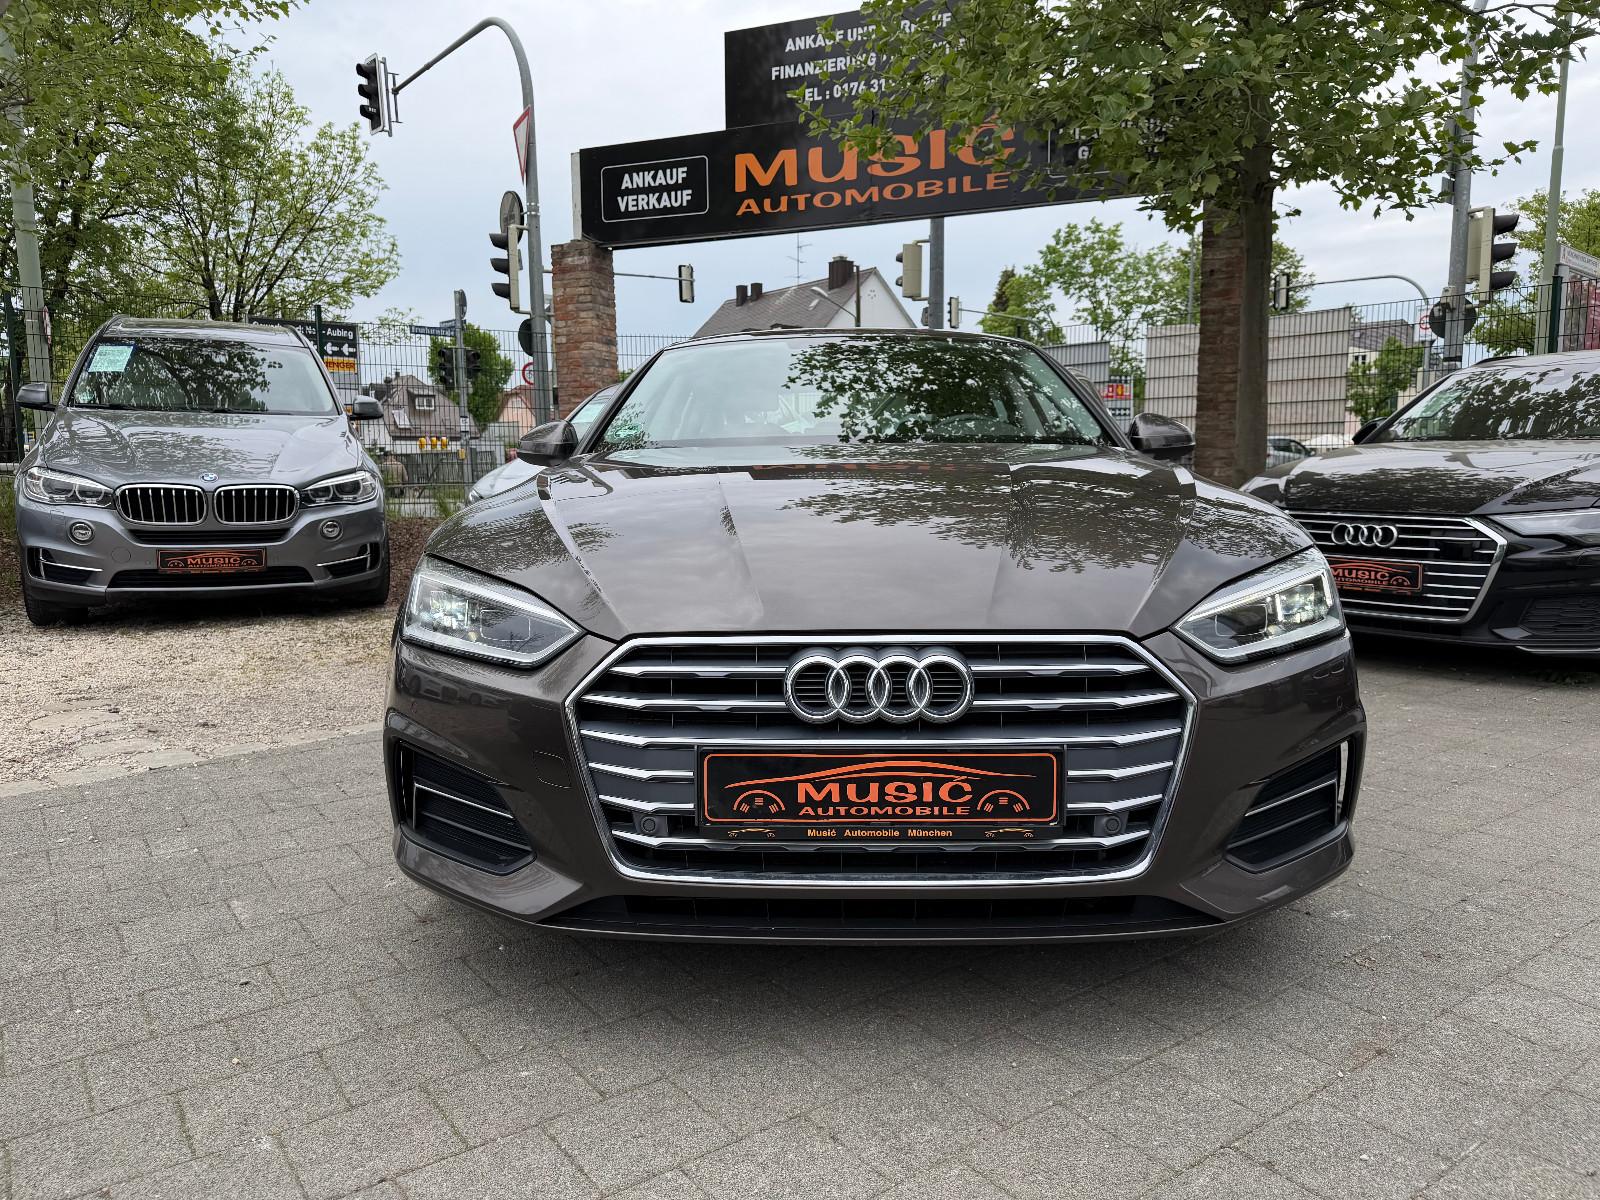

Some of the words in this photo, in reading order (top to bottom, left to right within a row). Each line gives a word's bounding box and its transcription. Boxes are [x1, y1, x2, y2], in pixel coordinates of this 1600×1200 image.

[621, 167, 688, 189] ANKAUF
[617, 190, 692, 212] VERKAUF
[735, 171, 1011, 216] AUTOMOBILE
[1334, 577, 1389, 585] UTOMOBILE
[798, 806, 971, 816] AUTOMOBILE
[844, 829, 900, 837] Automobile
[908, 829, 953, 837] München
